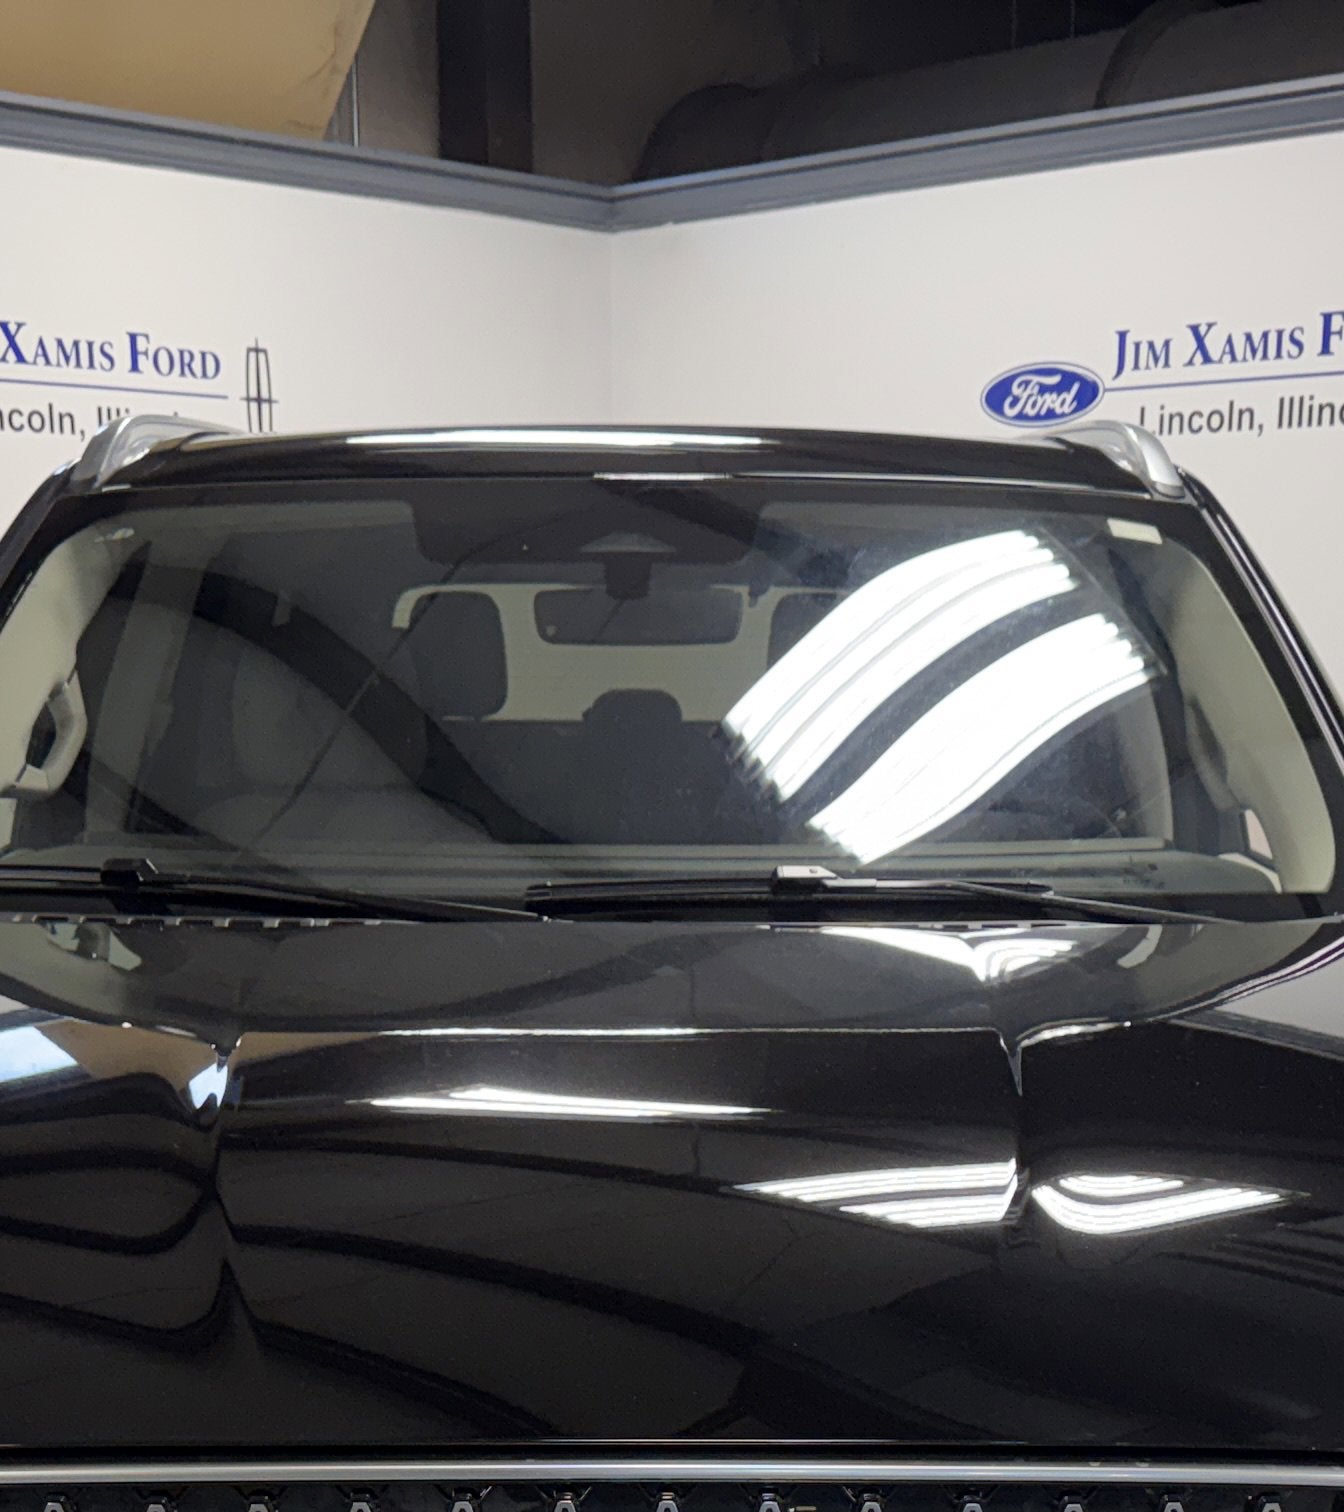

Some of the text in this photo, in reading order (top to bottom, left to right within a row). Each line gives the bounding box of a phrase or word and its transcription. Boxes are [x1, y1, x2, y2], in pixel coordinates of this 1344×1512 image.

[126, 332, 220, 380] FORD
[1112, 329, 1172, 380] JIM
[1183, 321, 1304, 368] XAMIS
[1004, 373, 1077, 418] Ford
